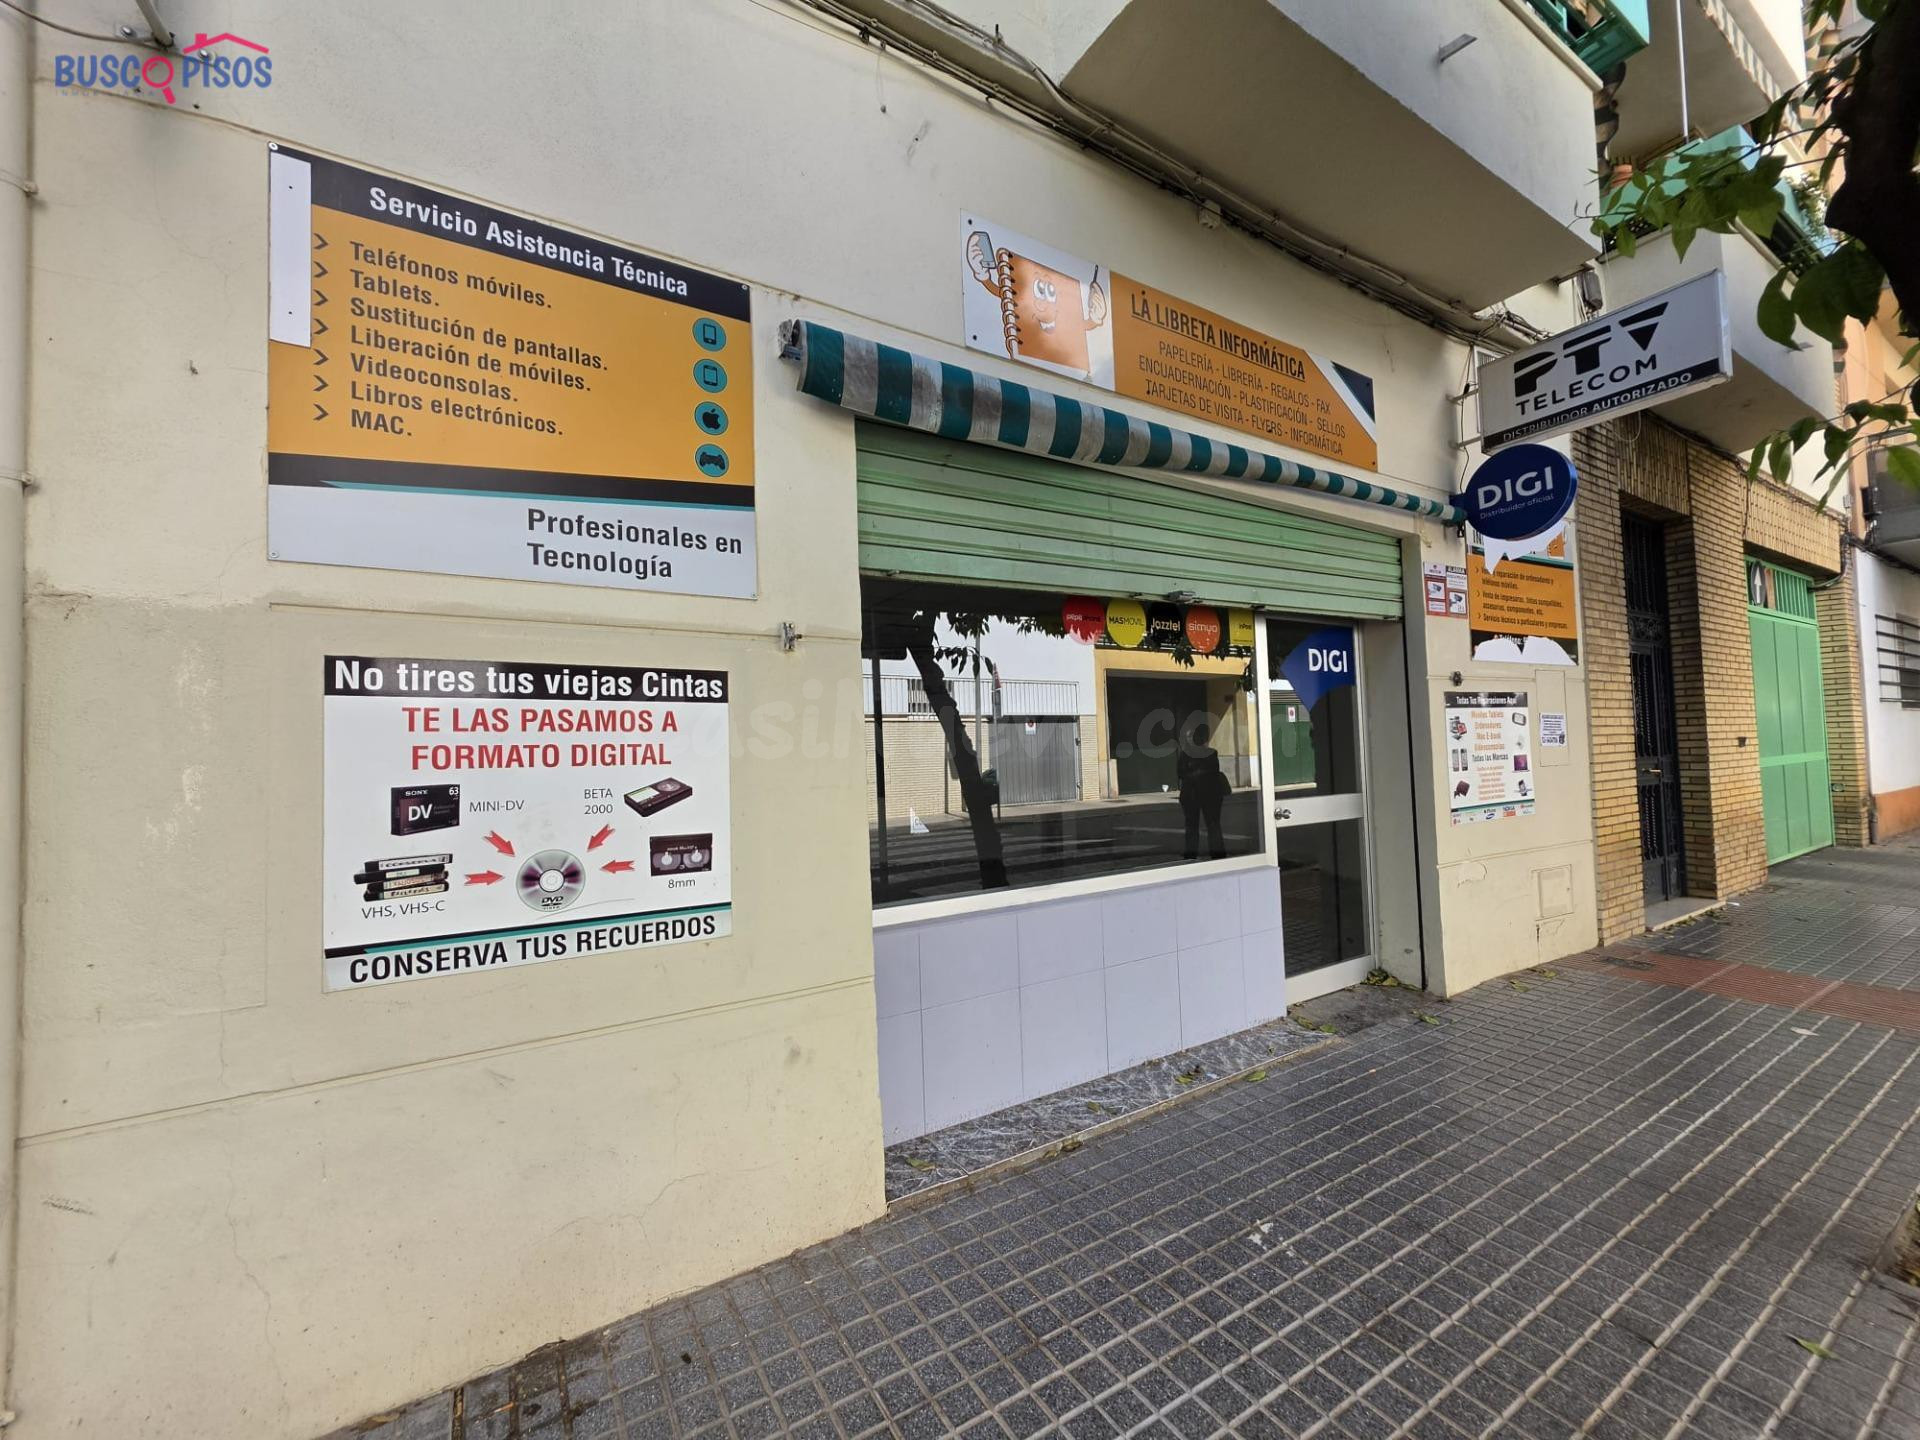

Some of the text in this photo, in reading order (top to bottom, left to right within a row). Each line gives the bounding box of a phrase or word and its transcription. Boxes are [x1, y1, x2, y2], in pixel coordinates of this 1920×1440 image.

[370, 187, 687, 296] Servicio Asistencia Técnica
[350, 241, 552, 308] Teléfonos móviles.
[350, 269, 440, 306] Tablets.
[350, 297, 609, 371] Sustitución de pantallas.
[1131, 293, 1305, 380] LA LIBRETA INFORMÁTICA
[1514, 302, 1669, 398] PTV
[350, 325, 591, 391] Liberación de móviles.
[350, 352, 518, 402] Videoconsolas.
[1159, 340, 1214, 374] PAPELERÍA
[1222, 363, 1263, 392] LIBRERÍA
[1271, 382, 1310, 408] REGALOS
[1316, 398, 1331, 415] FAX
[1139, 354, 1231, 400] ENCUADERNACIÓN
[1240, 391, 1308, 425] PLASTIFICACIÓN
[1317, 417, 1346, 439] SELLOS
[1503, 372, 1692, 442] DISTRIBUIDOR AUTORIZADO
[1515, 354, 1657, 416] TELECOM
[350, 381, 564, 436] Libros electrónicos.
[350, 409, 413, 437] MAC.
[1145, 378, 1196, 409] TARJETAS
[1199, 396, 1212, 414] DE
[1214, 401, 1244, 424] VISITA
[1251, 414, 1283, 437] FLYERS
[1290, 428, 1343, 456] INFORMÁTICA
[1478, 466, 1554, 510] DIGI
[528, 508, 742, 554] Profesionales en
[527, 542, 673, 580] Tecnología
[334, 660, 723, 701] No tires tus viejas Cintas
[1308, 648, 1348, 673] DIGI
[402, 707, 678, 733] TE LAS PASAMOS A
[411, 742, 672, 770] FORMATO DIGITAL
[405, 789, 429, 797] SONY
[408, 803, 433, 822] DV
[448, 786, 459, 796] 63
[468, 799, 525, 814] MINI-DV
[584, 788, 613, 800] BETA
[584, 804, 613, 815] 2000
[668, 879, 696, 889] 8mm
[361, 899, 446, 920] VHS, VHS-C
[349, 915, 716, 985] CONSERVA TUS RECUERDOS
